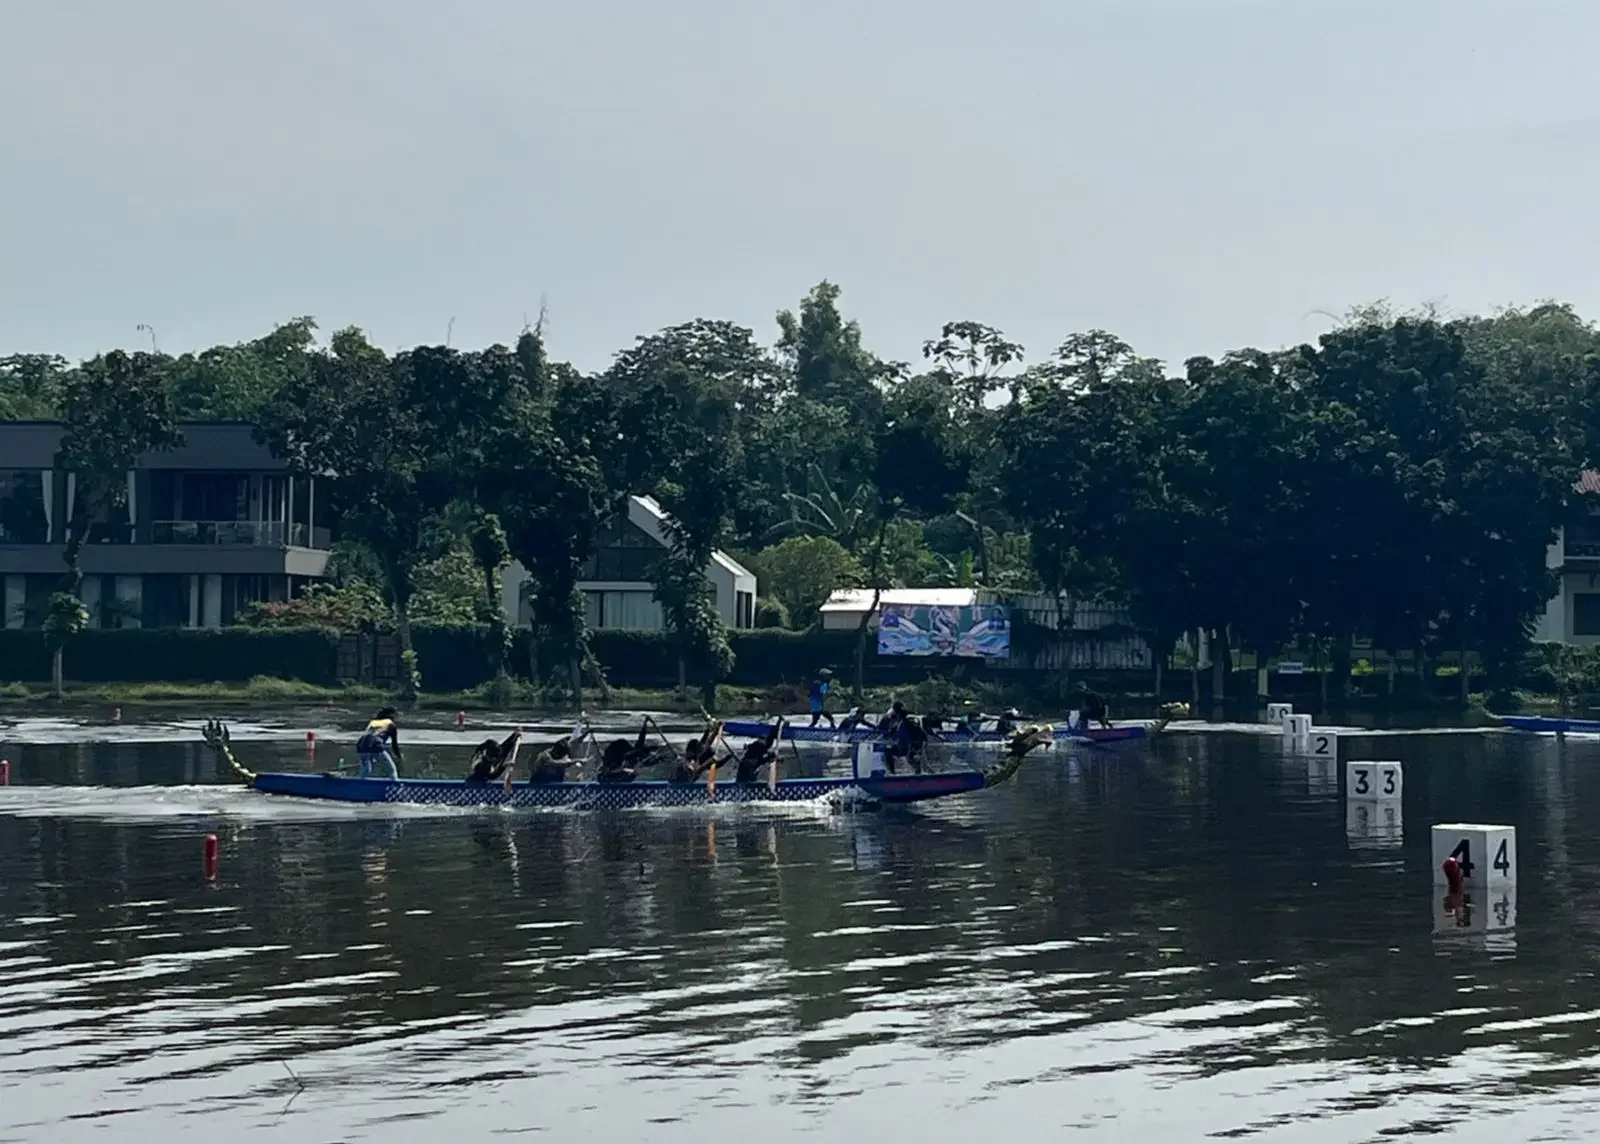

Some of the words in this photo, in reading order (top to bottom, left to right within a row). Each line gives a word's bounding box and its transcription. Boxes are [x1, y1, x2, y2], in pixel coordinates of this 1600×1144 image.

[1290, 719, 1296, 733] 1
[1315, 737, 1329, 754] 2
[1355, 770, 1369, 794] 3
[1383, 770, 1395, 794] 3
[1449, 839, 1475, 878] 4
[1493, 838, 1509, 877] 4
